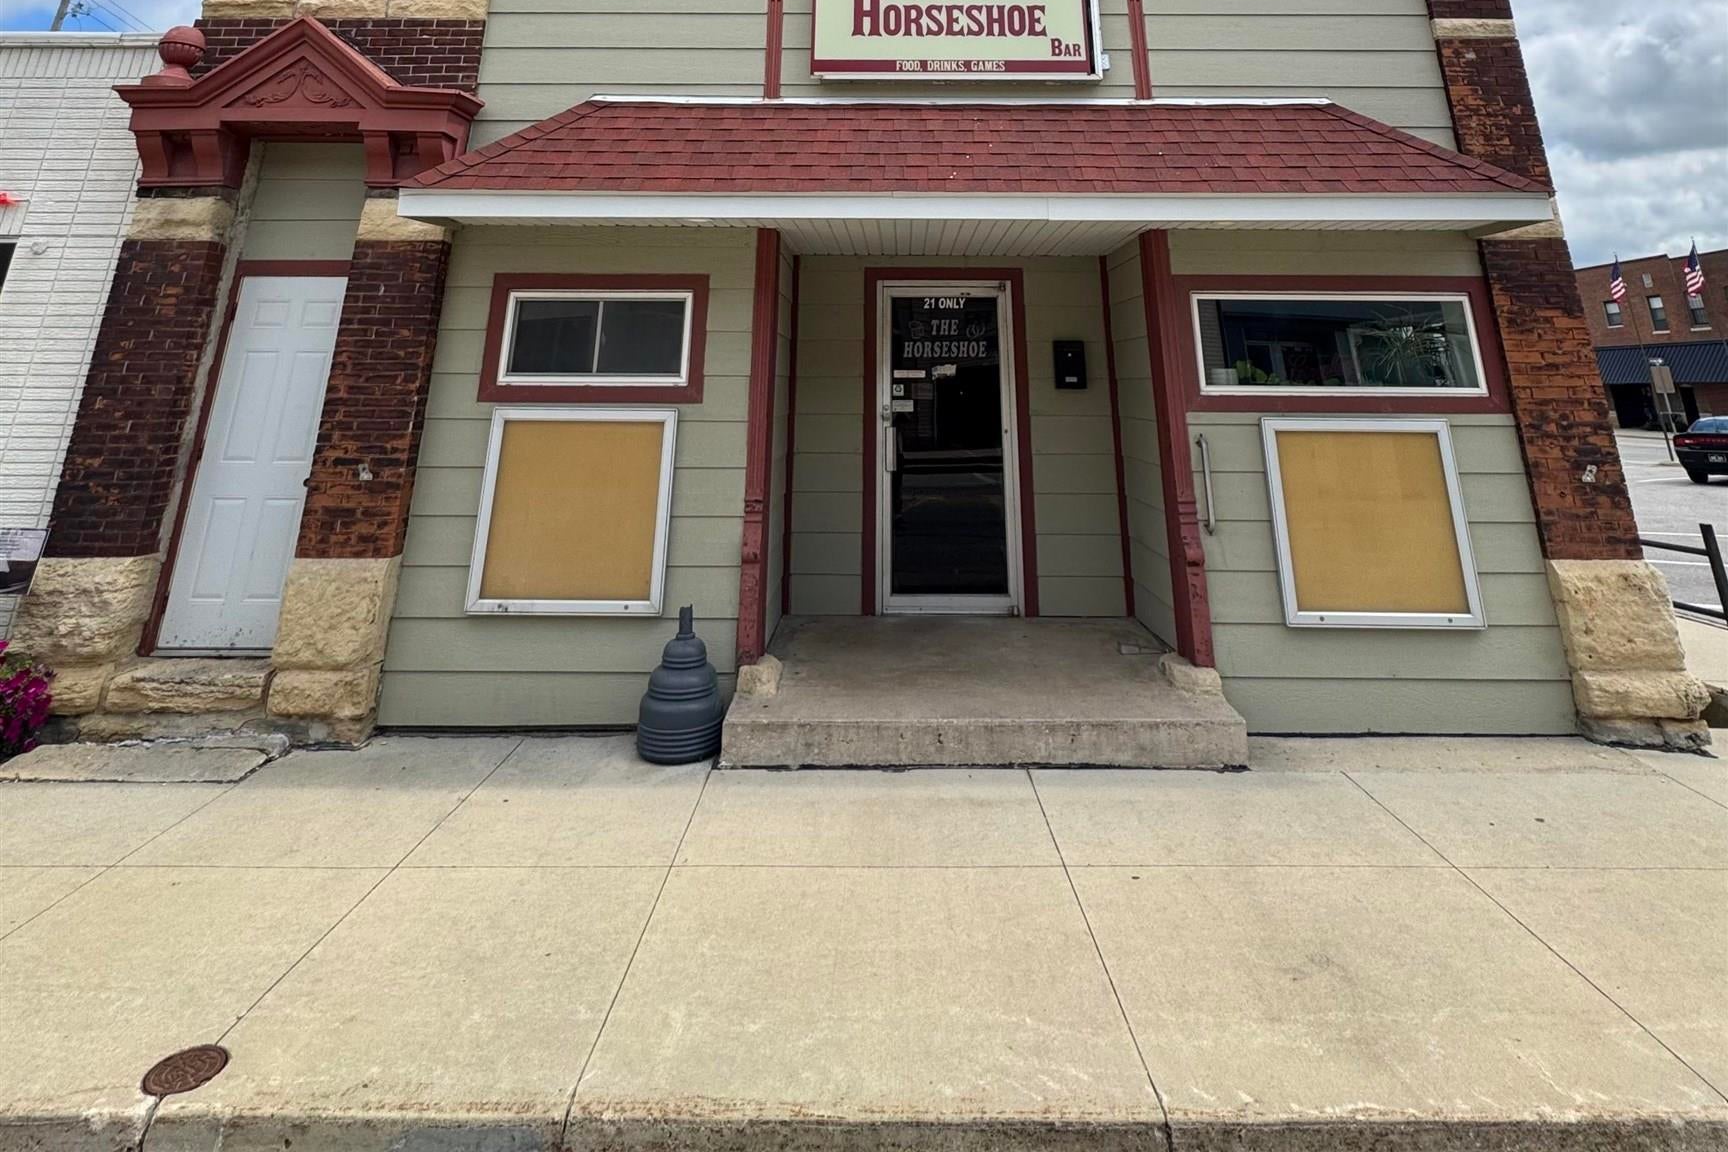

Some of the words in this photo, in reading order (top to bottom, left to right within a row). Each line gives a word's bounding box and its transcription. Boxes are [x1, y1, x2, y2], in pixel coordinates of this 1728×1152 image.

[1050, 38, 1082, 57] BAR
[896, 60, 923, 72] FOOD,
[927, 60, 968, 72] DRINKS,
[970, 60, 1006, 72] GAMES
[923, 297, 936, 309] 21
[938, 297, 966, 309] ONLY
[930, 319, 960, 336] THE
[903, 341, 987, 358] HORSESHOE
